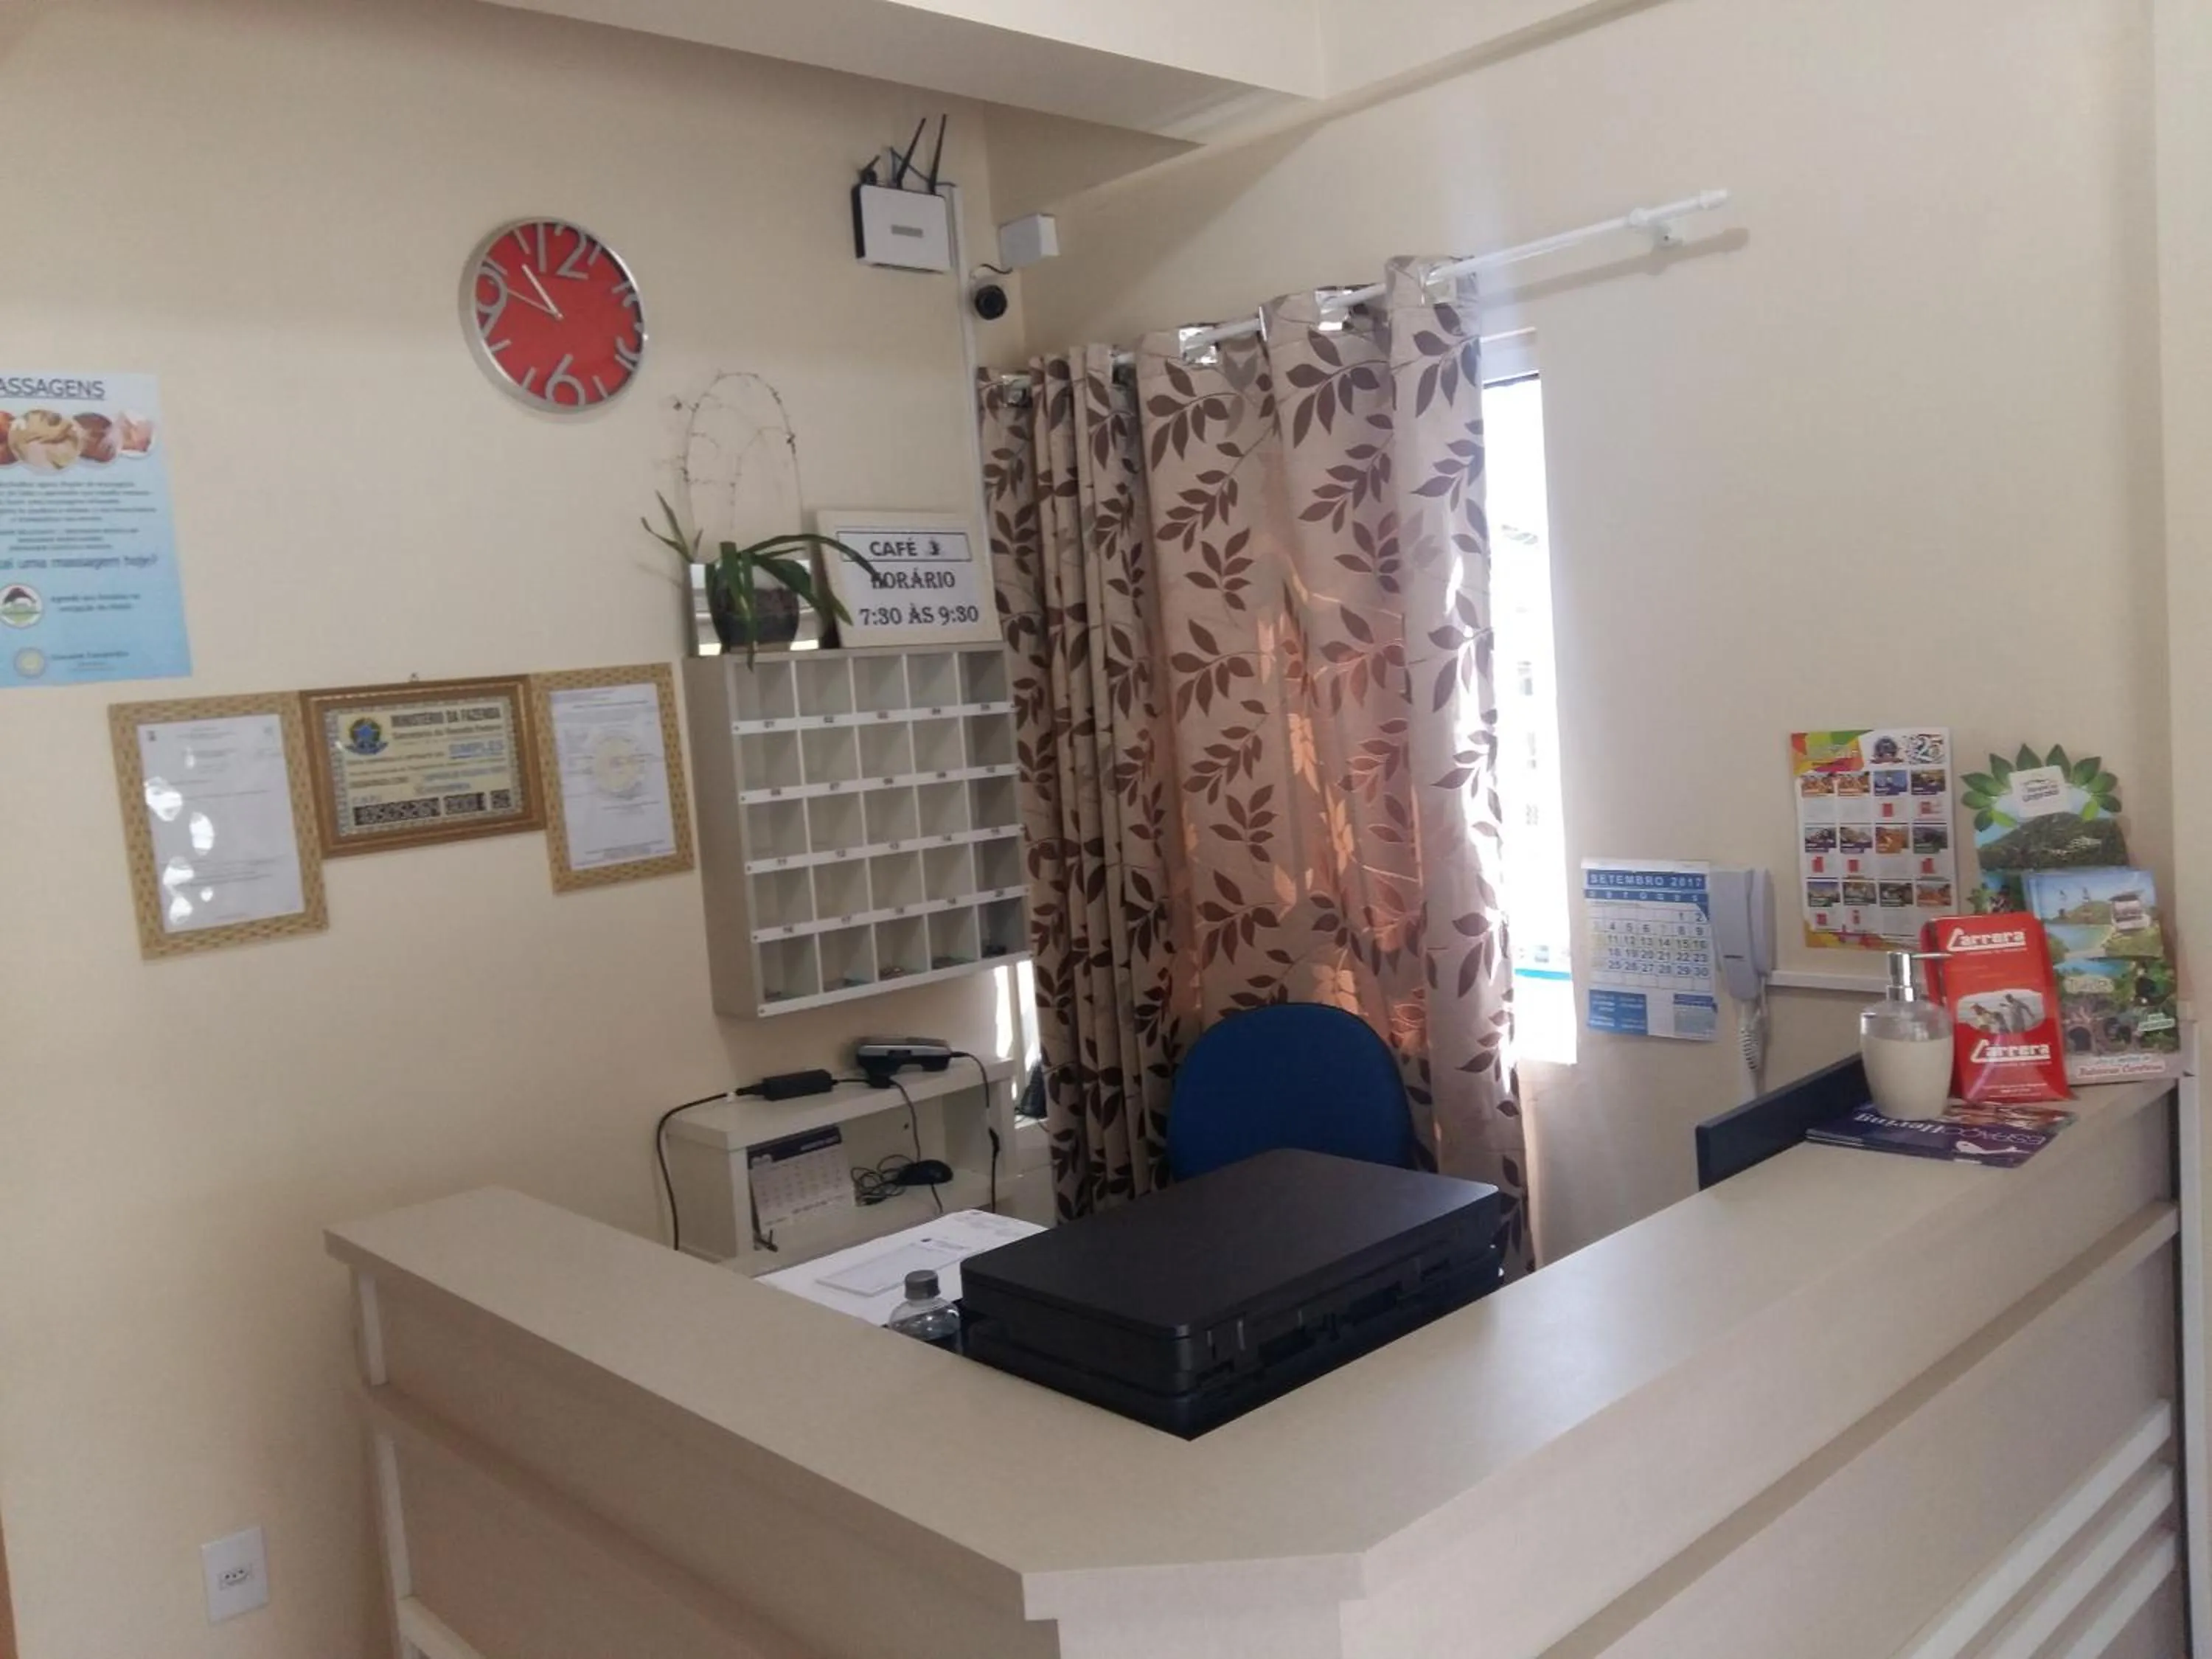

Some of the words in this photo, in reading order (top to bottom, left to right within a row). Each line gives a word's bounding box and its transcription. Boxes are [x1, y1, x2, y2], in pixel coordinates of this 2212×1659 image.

[869, 538, 918, 557] CAFÉ
[859, 607, 902, 626] 7:30
[937, 605, 979, 625] 9:30
[1589, 874, 1664, 886] SETEMBRO
[1670, 877, 1703, 887] 2017
[1947, 928, 2026, 951] Carrera
[1970, 1039, 2051, 1062] Carrera
